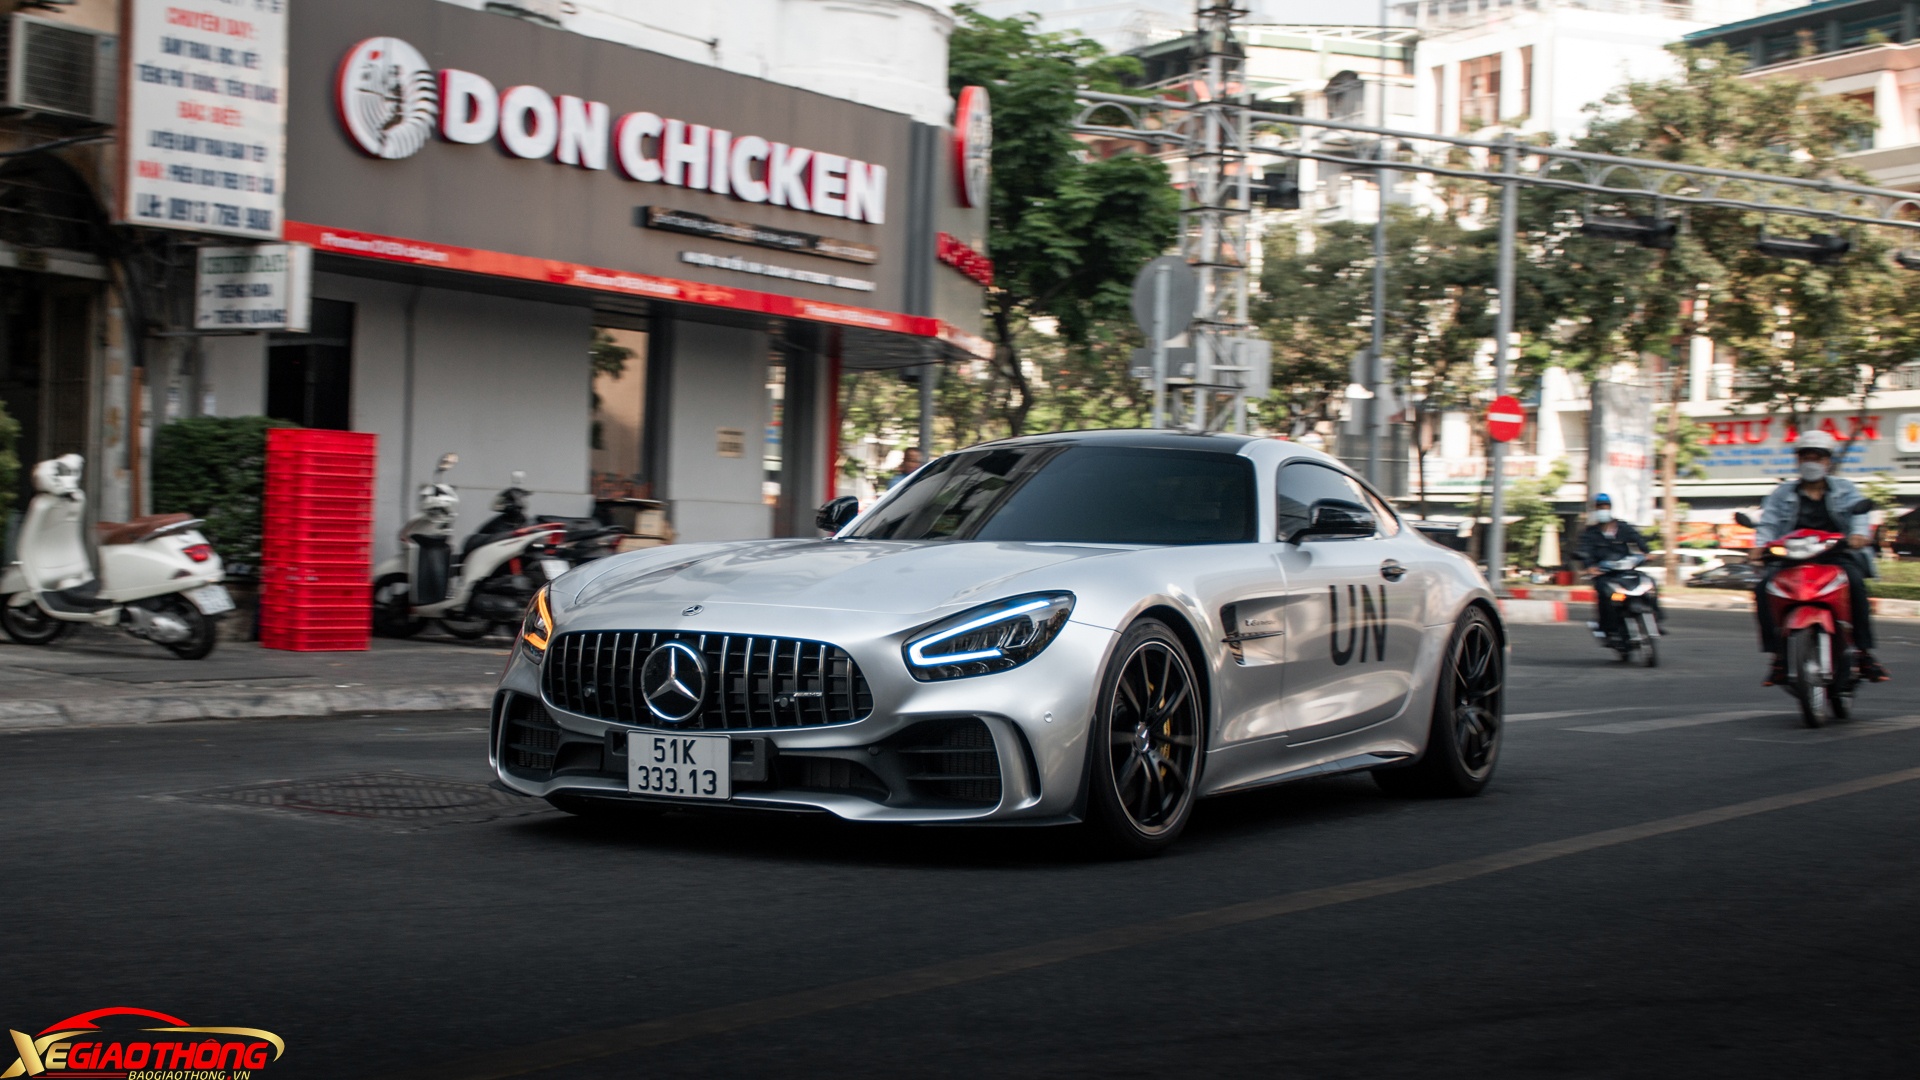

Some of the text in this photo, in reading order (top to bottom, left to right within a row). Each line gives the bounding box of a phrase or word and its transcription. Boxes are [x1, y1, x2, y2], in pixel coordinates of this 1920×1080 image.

[439, 68, 888, 225] DON CHICKEN
[1329, 584, 1387, 666] UN
[653, 738, 697, 764] 51K
[637, 766, 717, 795] 333.13
